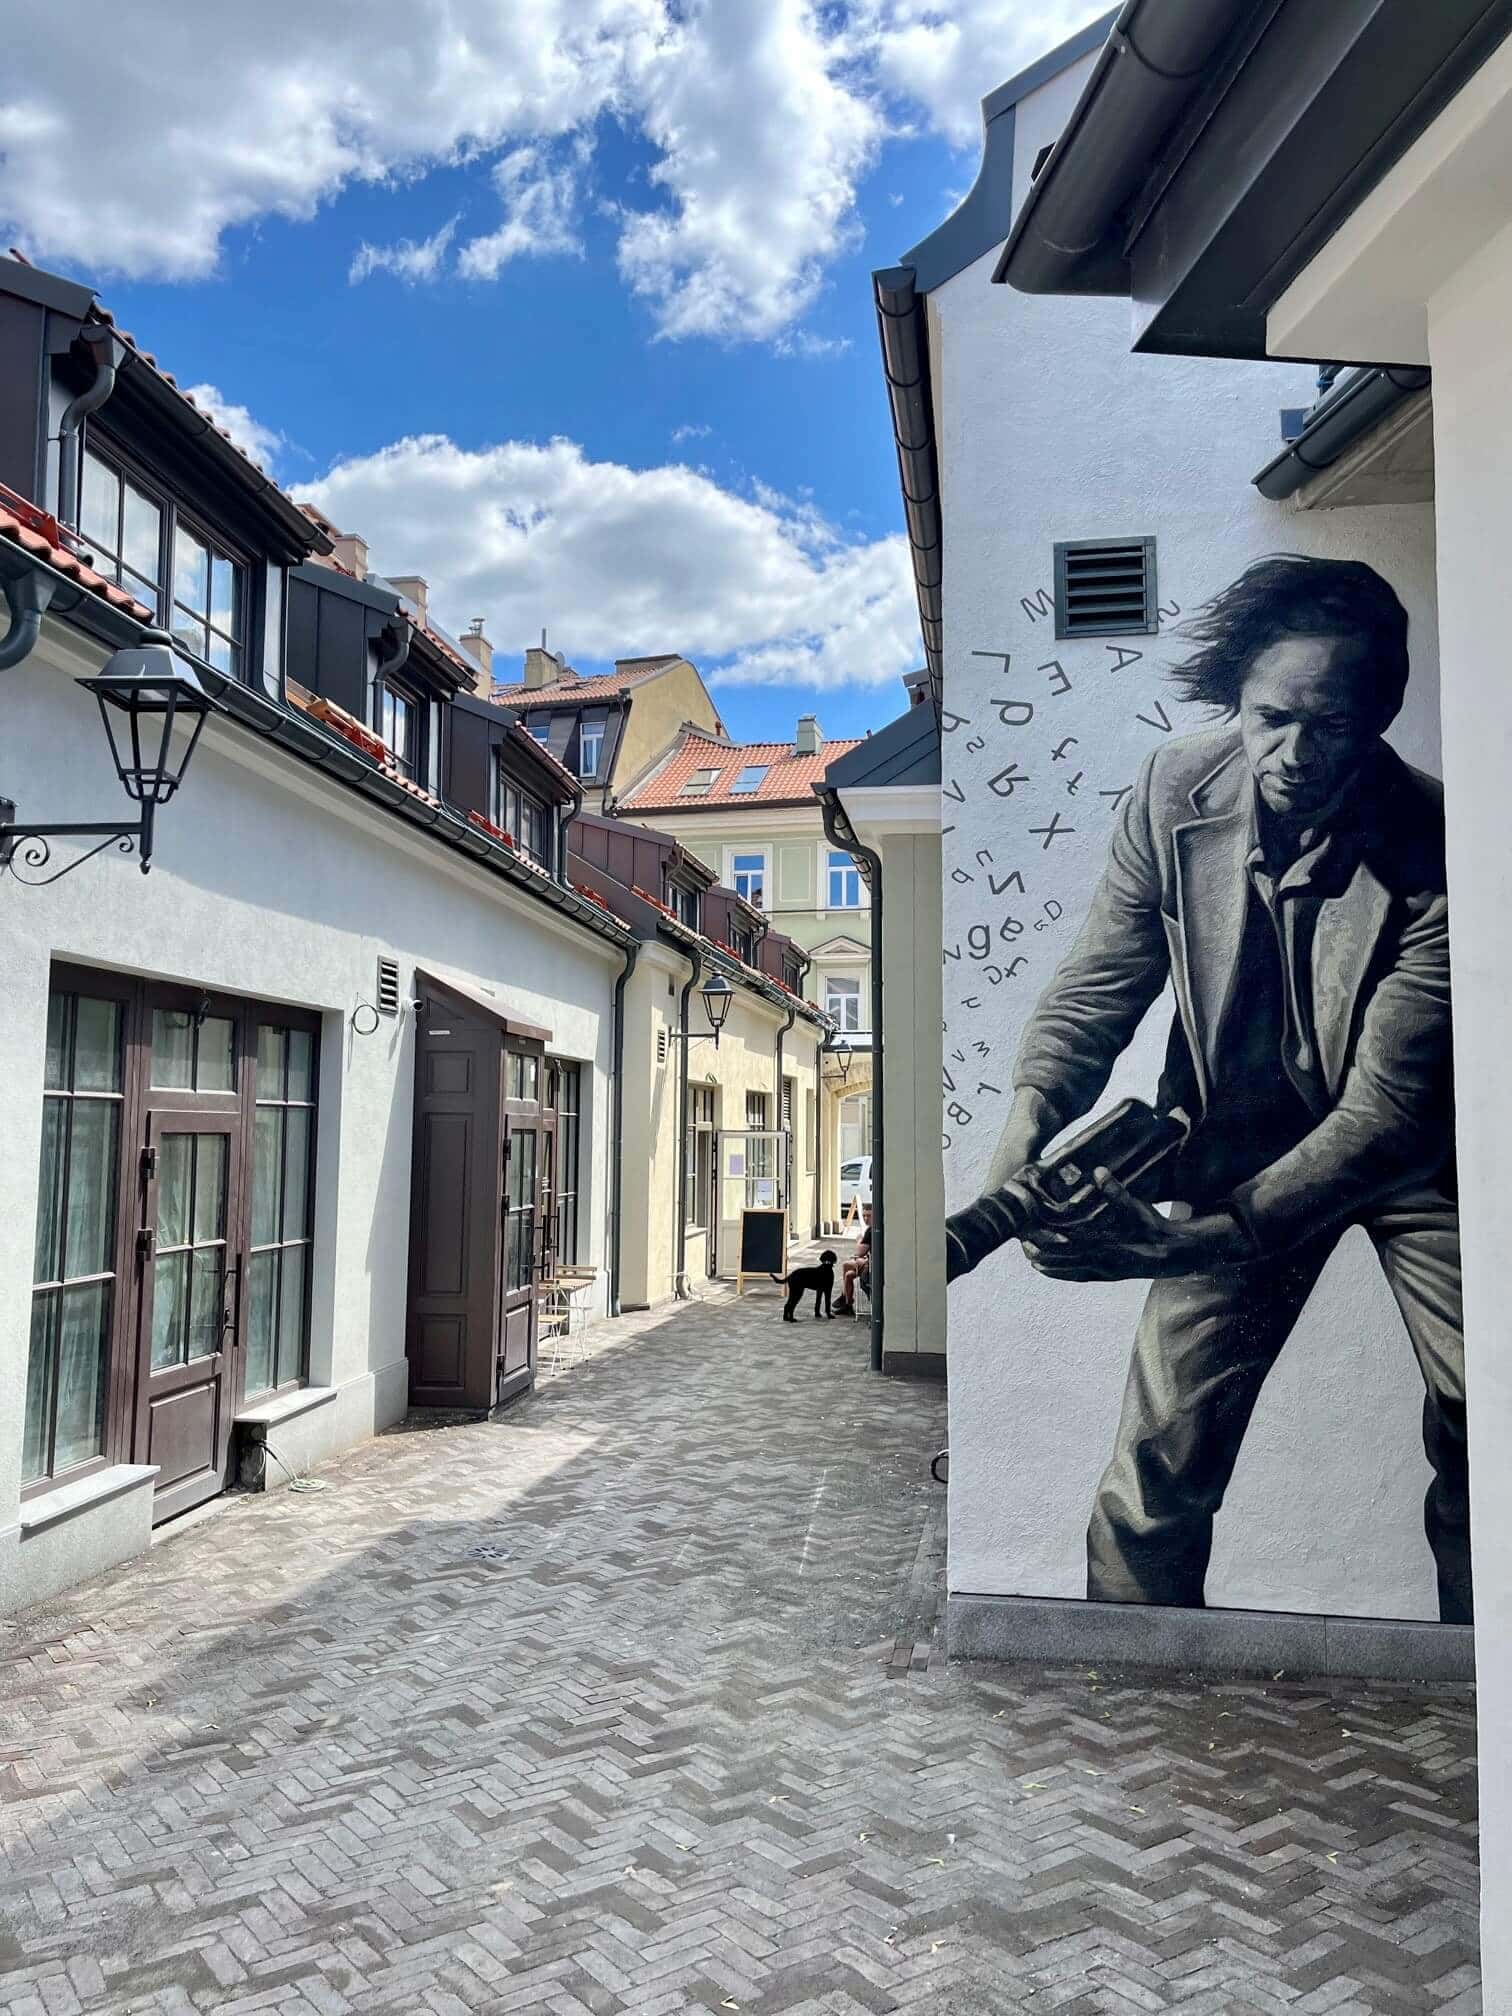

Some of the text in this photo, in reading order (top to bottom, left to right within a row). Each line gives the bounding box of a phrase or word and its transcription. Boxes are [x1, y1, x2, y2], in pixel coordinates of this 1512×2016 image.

[1106, 646, 1142, 673] A
[1038, 661, 1072, 696] E
[948, 1102, 972, 1125] B
